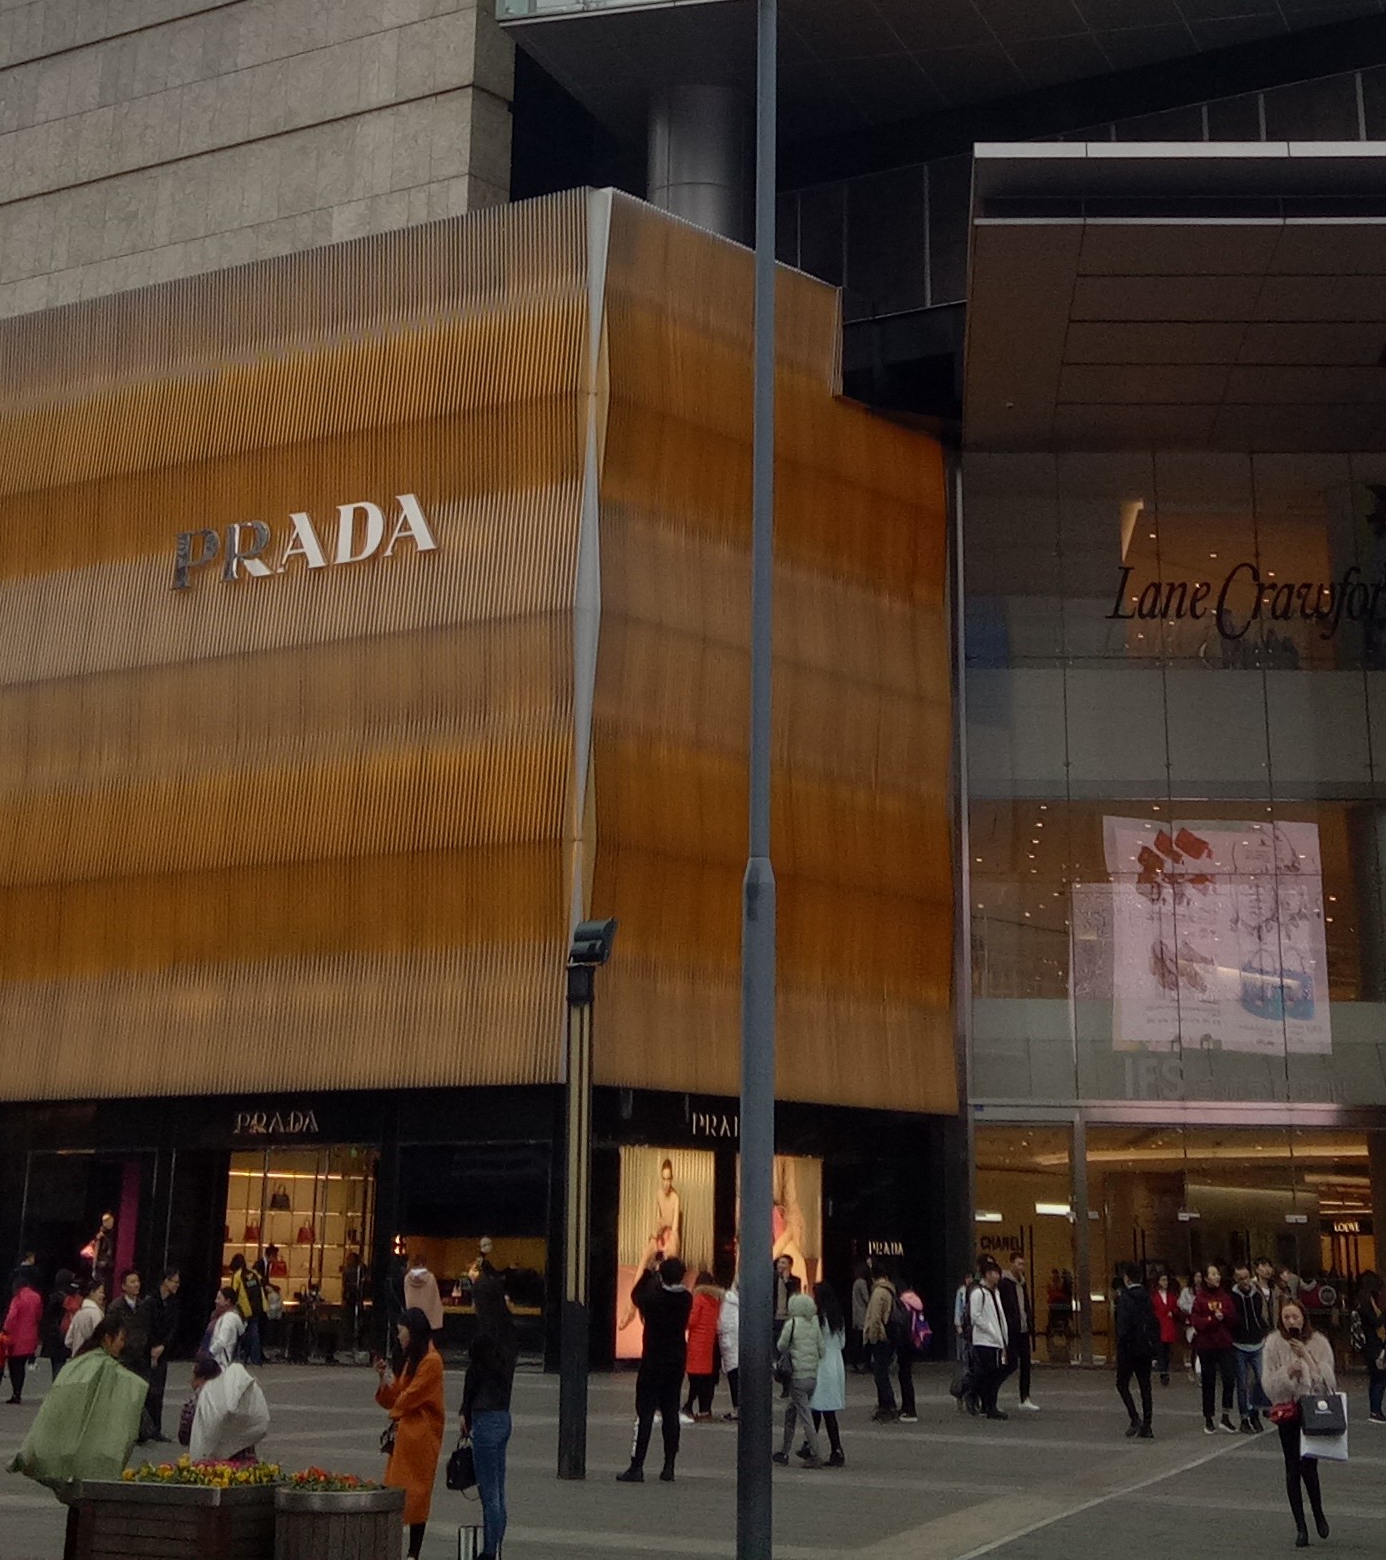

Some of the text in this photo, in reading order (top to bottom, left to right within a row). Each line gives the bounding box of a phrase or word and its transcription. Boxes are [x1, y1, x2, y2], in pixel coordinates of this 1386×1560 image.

[169, 493, 439, 591] PRADA
[1105, 566, 1211, 620] Lane
[233, 1109, 320, 1135] PRADA
